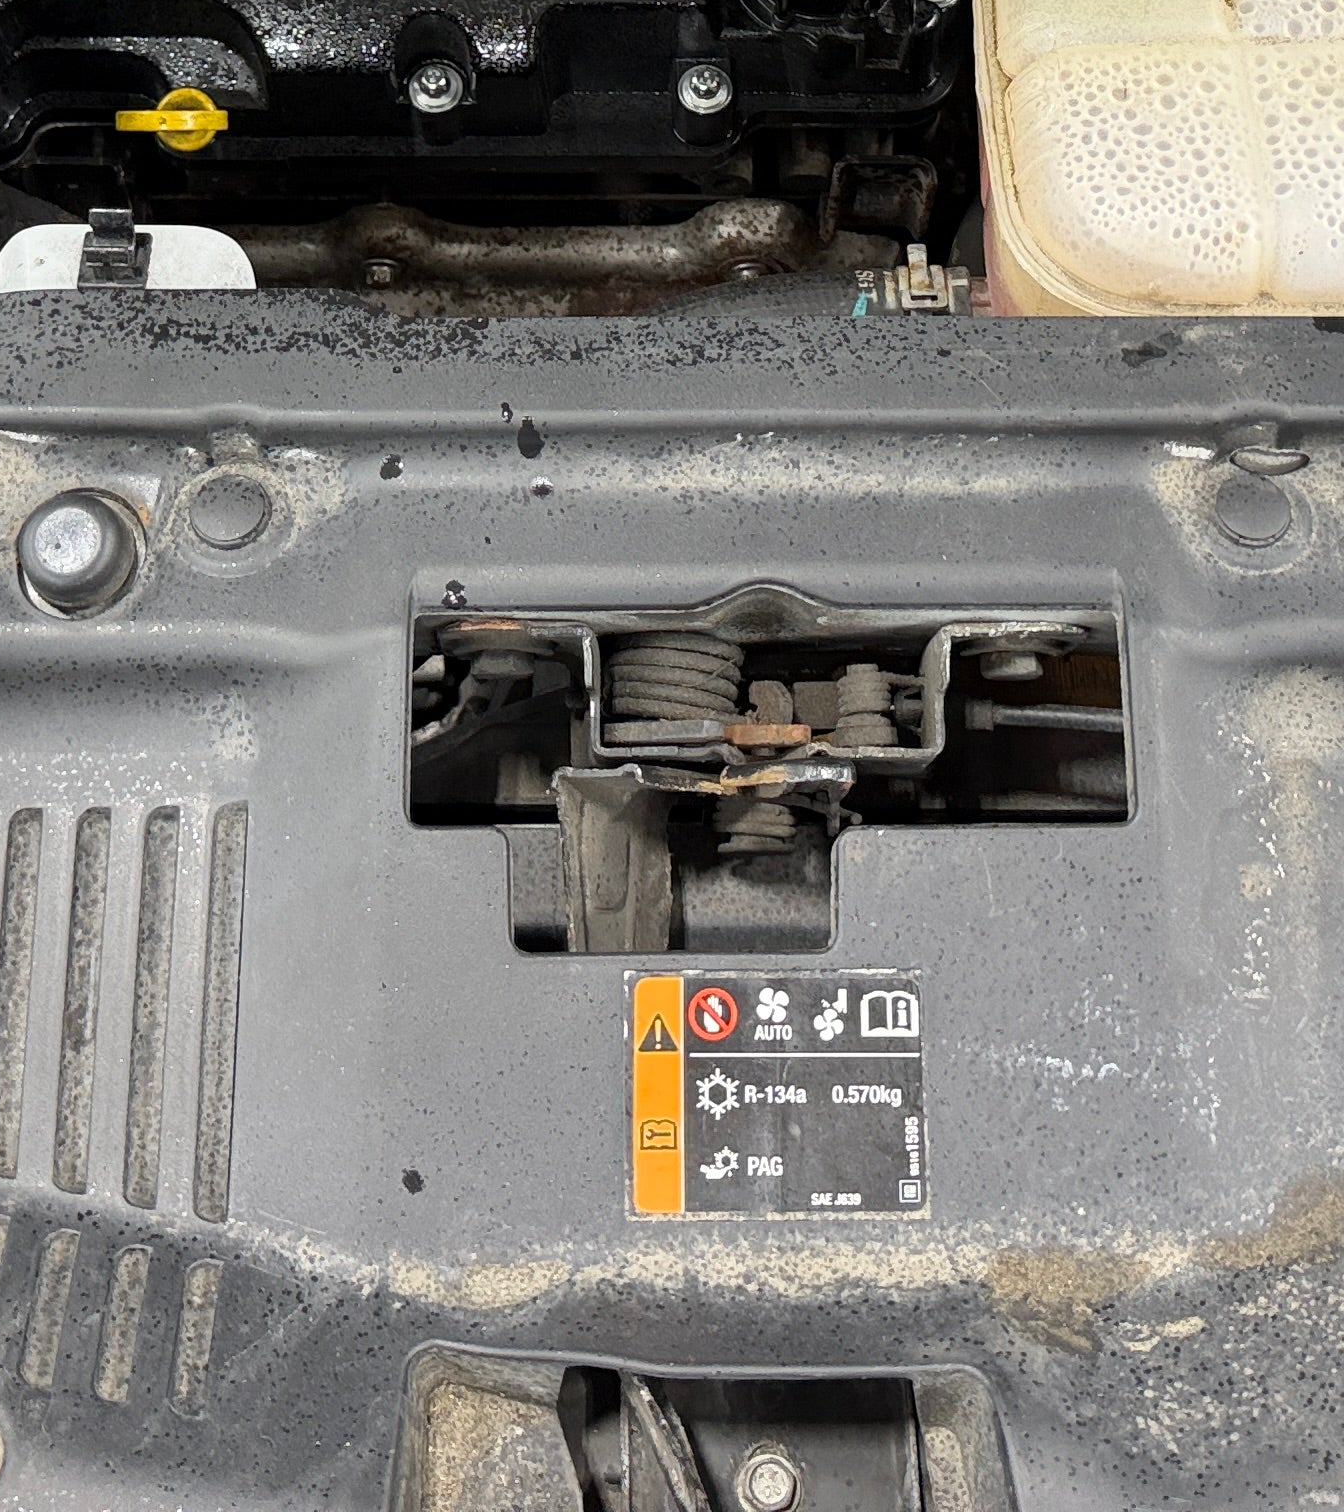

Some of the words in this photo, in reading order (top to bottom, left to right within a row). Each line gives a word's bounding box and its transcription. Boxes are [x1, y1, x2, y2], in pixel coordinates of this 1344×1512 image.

[753, 1025, 793, 1041] AUTO
[744, 1085, 808, 1104] R-134a
[831, 1085, 903, 1107] 0.570kg
[747, 1156, 784, 1177] PAG
[810, 1193, 833, 1206] SAE
